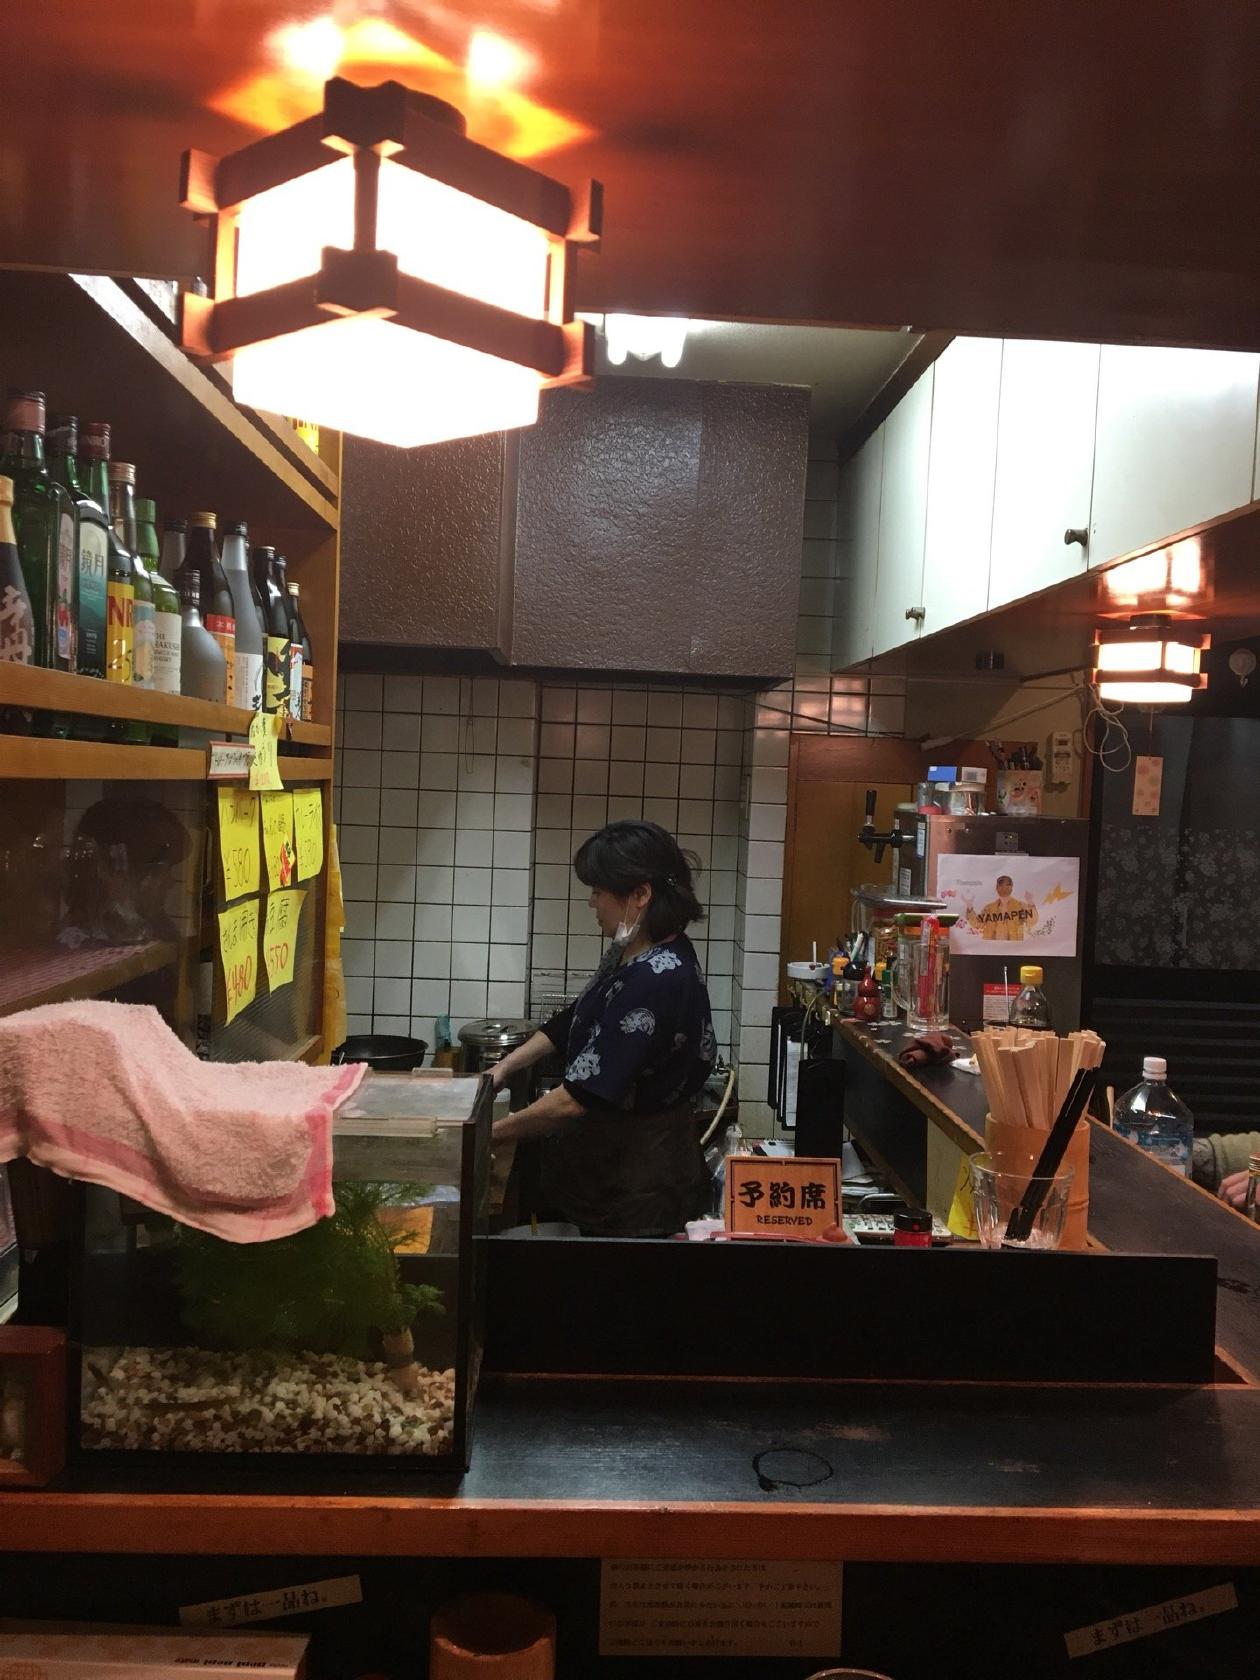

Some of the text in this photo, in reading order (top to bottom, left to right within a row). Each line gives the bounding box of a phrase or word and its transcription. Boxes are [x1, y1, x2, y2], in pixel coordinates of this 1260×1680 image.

[977, 908, 1033, 923] YAMAPEN
[738, 1180, 827, 1211] 予約席
[756, 1214, 813, 1226] RESERVED
